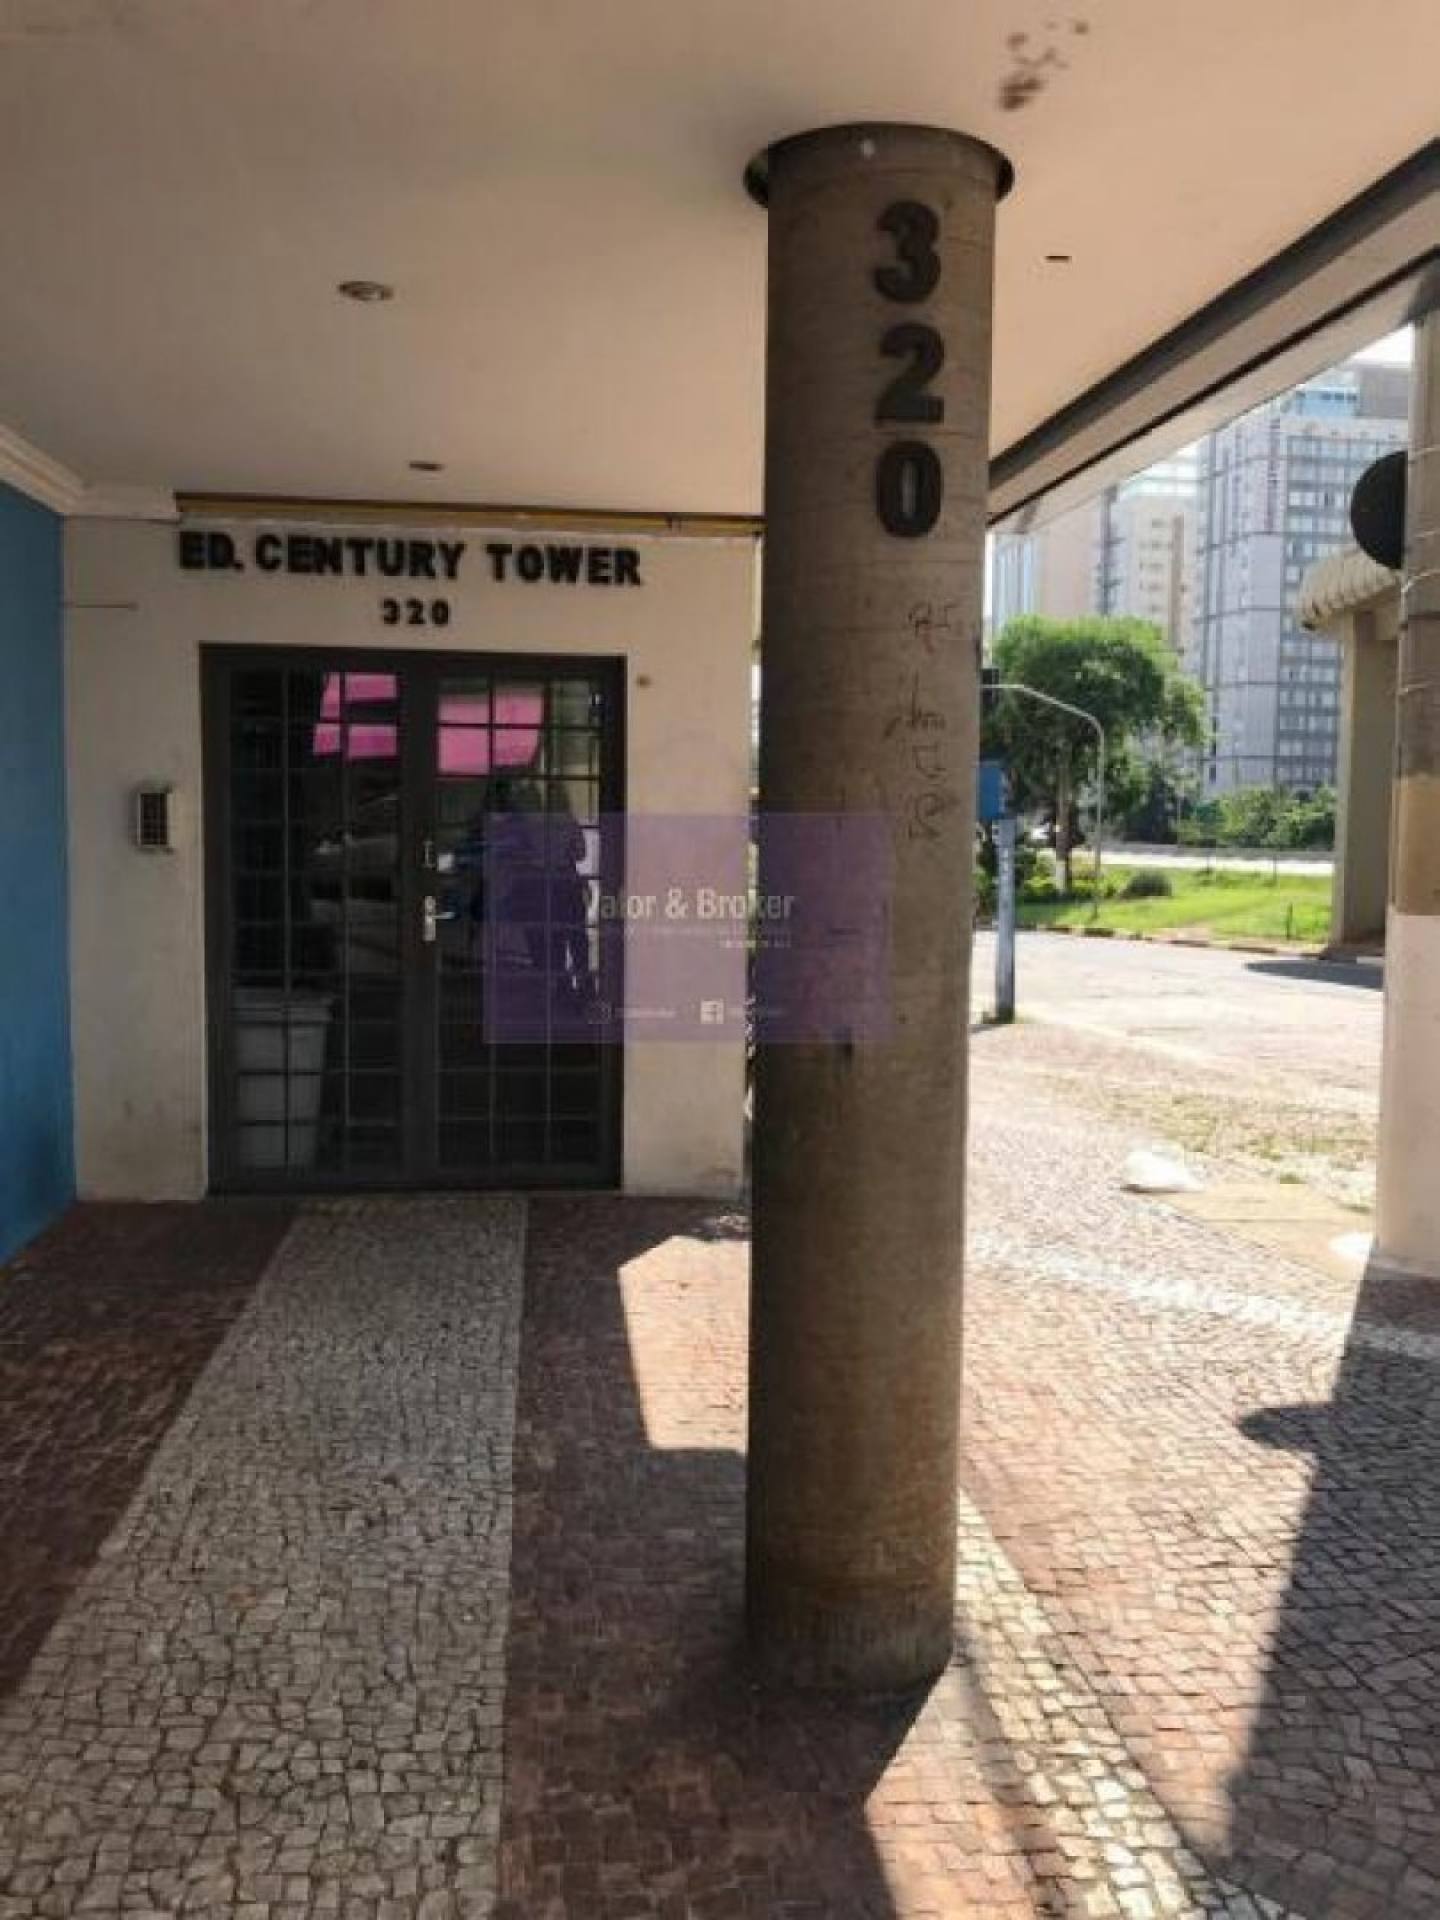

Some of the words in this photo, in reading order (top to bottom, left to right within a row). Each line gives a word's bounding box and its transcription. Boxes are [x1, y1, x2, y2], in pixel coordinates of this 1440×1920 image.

[874, 200, 944, 538] 320
[179, 530, 244, 571] ED.
[255, 533, 465, 580] CENTURY
[485, 543, 641, 586] TOWER
[382, 598, 450, 626] 320
